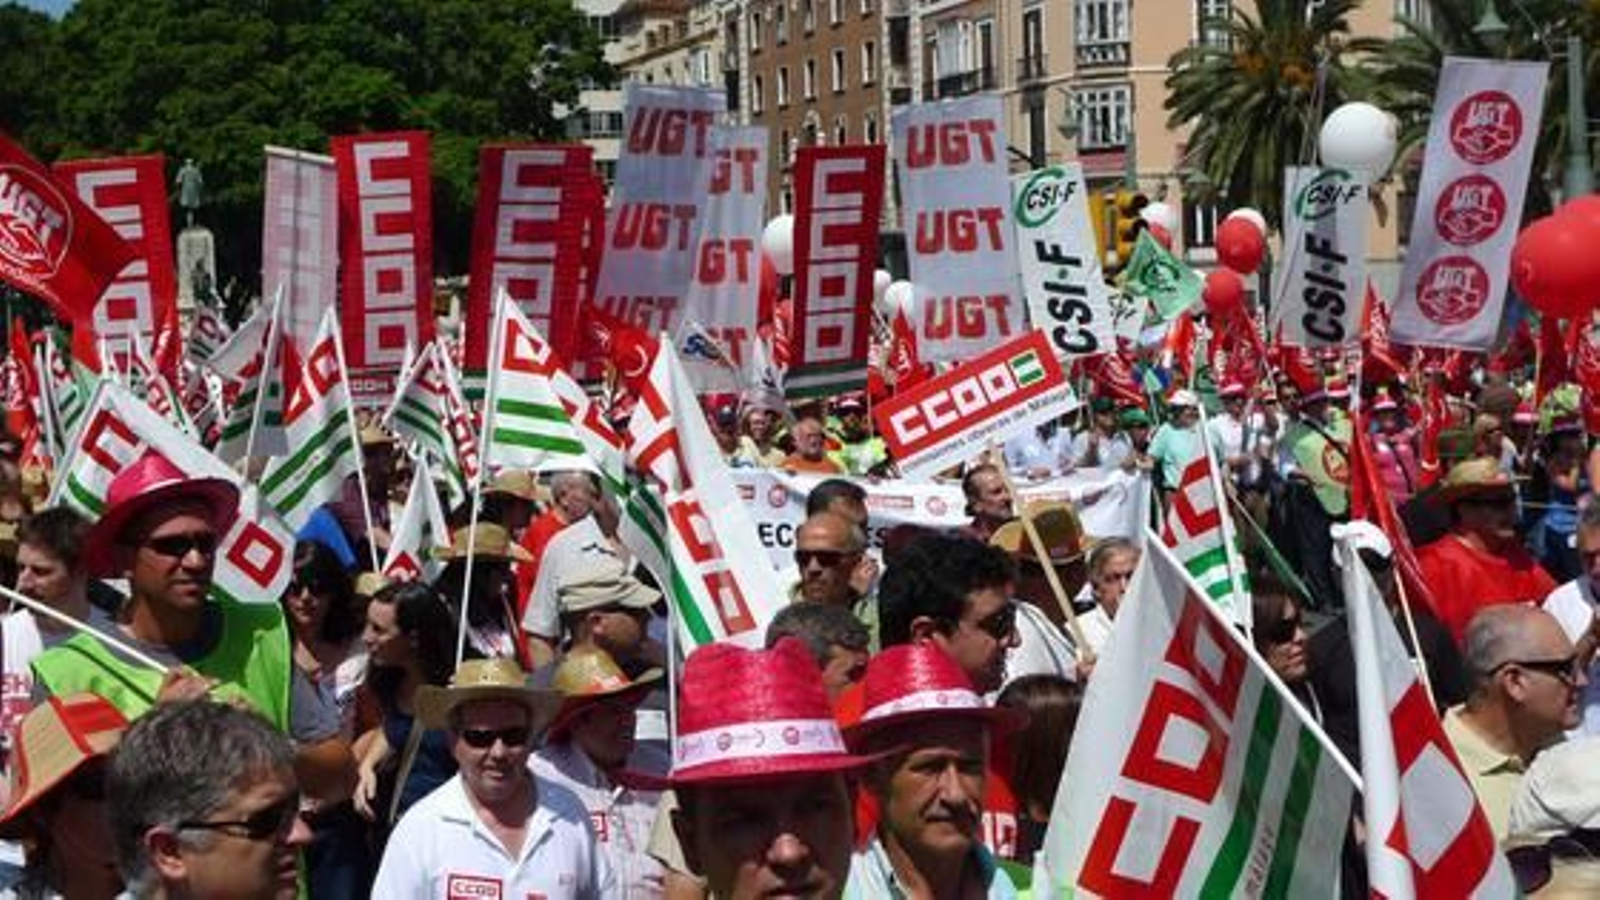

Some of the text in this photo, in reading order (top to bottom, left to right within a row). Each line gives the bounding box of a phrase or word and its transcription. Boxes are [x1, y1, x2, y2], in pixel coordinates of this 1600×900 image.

[626, 106, 713, 158] UGT
[905, 118, 997, 170] UGT
[709, 148, 759, 194] GT
[612, 204, 698, 251] UGT
[914, 208, 1006, 254] UGT
[698, 238, 754, 285] GT
[804, 158, 867, 364] CCOO
[923, 295, 1013, 340] UGT
[890, 361, 1018, 446] CCOO
[757, 523, 795, 548] EC
